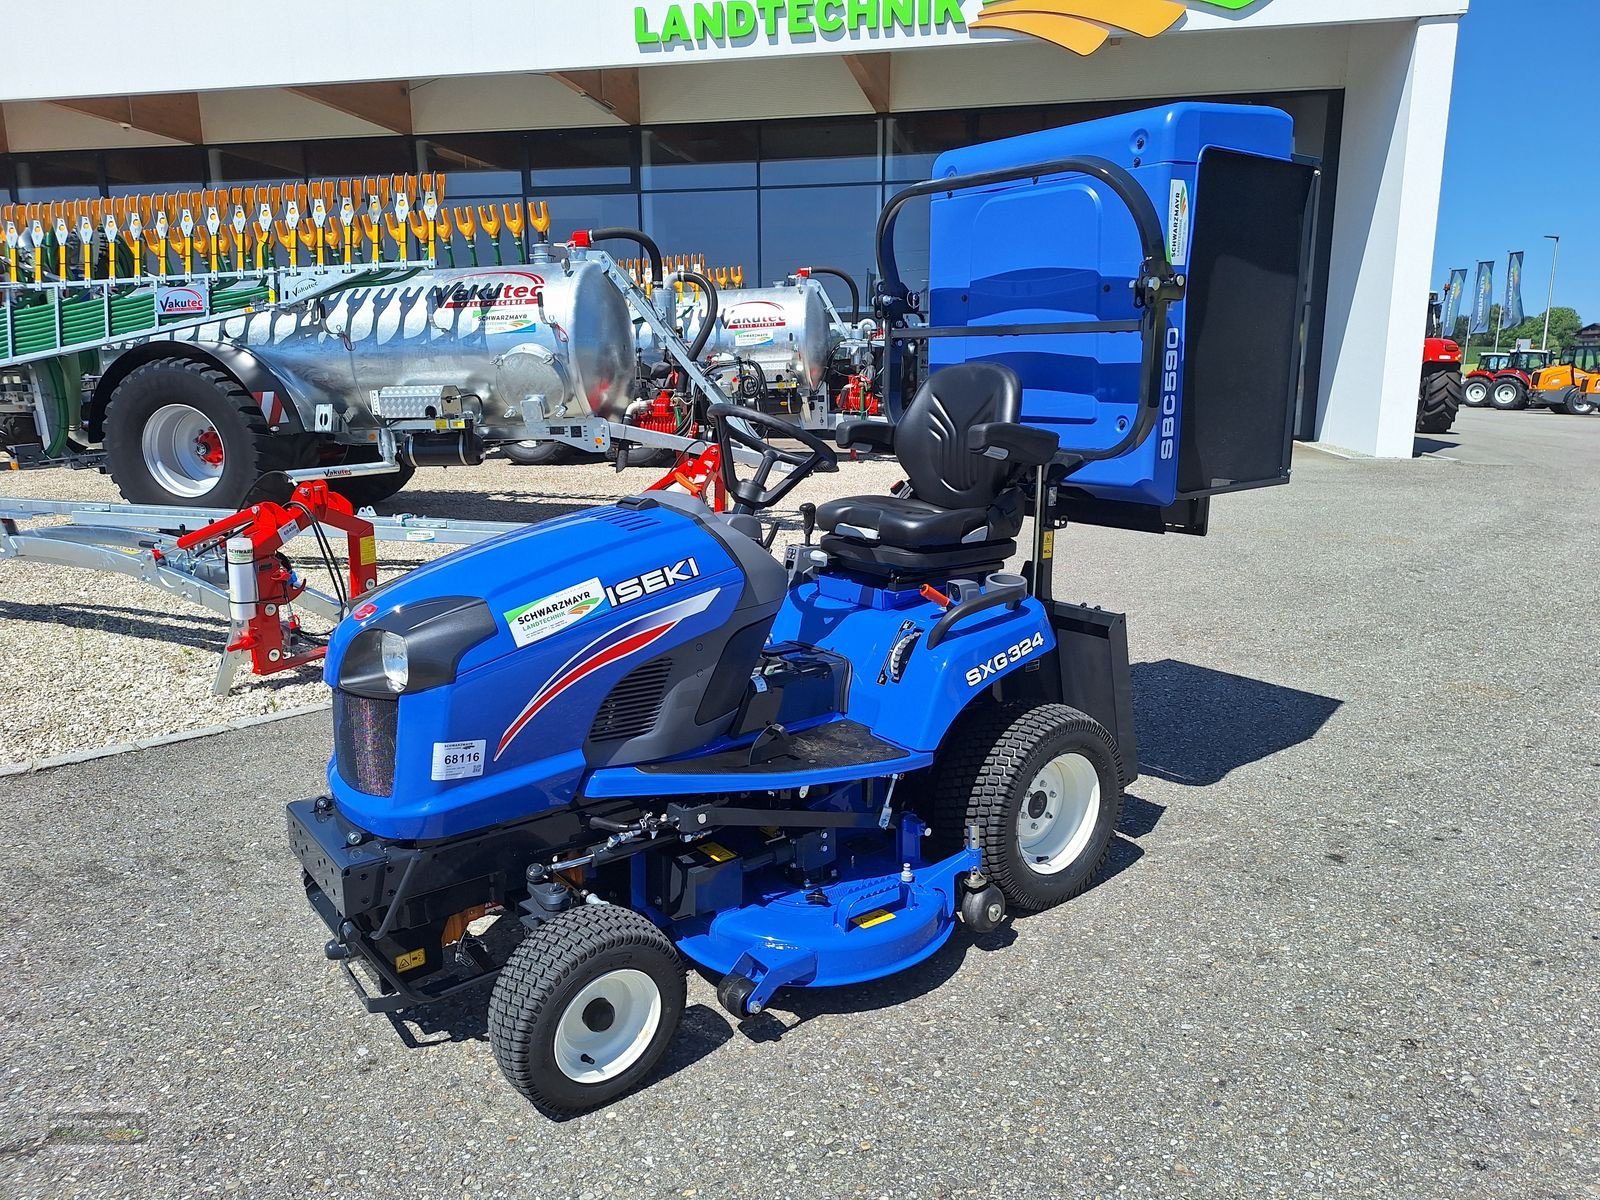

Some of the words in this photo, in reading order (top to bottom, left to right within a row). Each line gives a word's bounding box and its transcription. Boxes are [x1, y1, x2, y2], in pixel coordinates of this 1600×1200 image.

[634, 0, 966, 45] LANDTECHNIK
[1171, 192, 1180, 258] SCHWARZMAYR
[159, 296, 203, 313] Vakutec
[291, 282, 319, 298] Vakutec
[435, 281, 544, 309] Vakutec
[477, 313, 528, 321] SCHWARZMAYR
[1160, 327, 1179, 460] SBC590
[604, 557, 701, 608] ISEKI
[517, 591, 591, 626] SCHWARZMAYR
[522, 610, 566, 632] LANDTECHNIK
[965, 631, 1044, 687] SXG324
[444, 752, 480, 765] 68116
